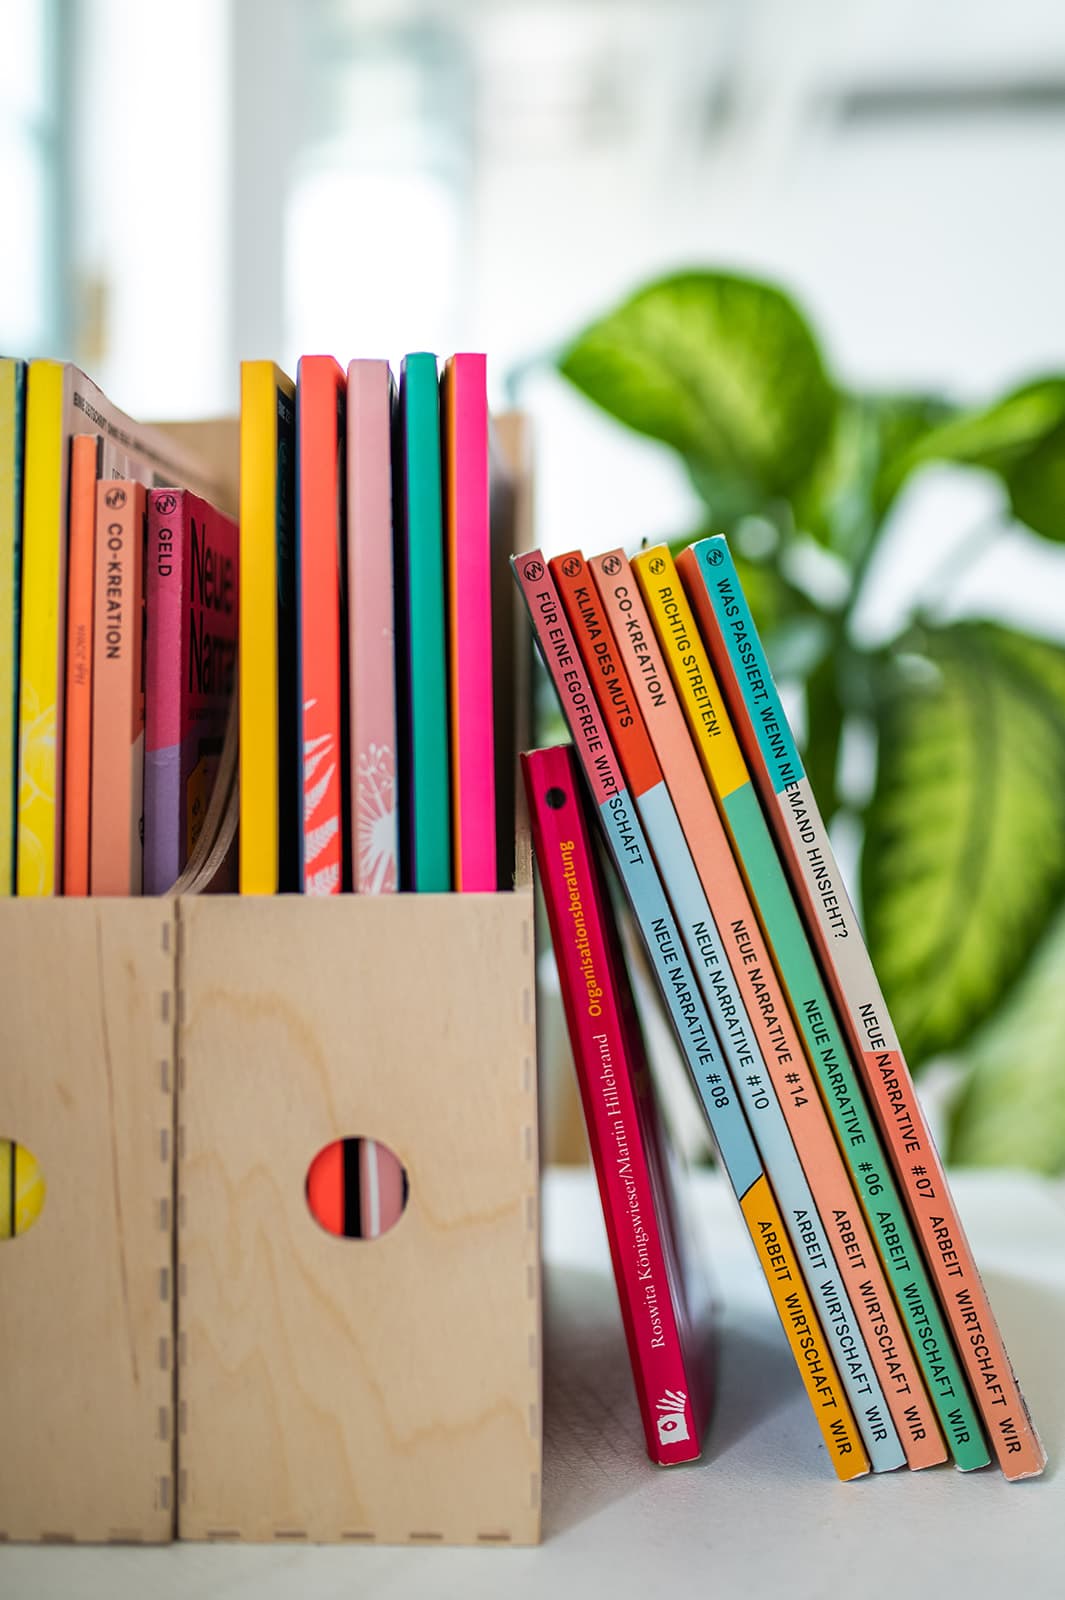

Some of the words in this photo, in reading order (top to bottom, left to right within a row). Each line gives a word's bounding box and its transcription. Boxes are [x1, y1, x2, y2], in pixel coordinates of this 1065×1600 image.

[106, 523, 123, 659] CO-KREATION
[158, 528, 173, 577] GELD
[190, 517, 232, 615] Neue
[614, 586, 667, 707] CO-KREATION
[536, 592, 558, 625] FÜR
[549, 628, 573, 668] EINE
[564, 670, 603, 752] EGOFREIE
[594, 754, 644, 865] WIRTSCHAFT
[574, 587, 602, 640] KLIMA
[593, 642, 615, 676] DES
[606, 678, 634, 728] MUTS
[658, 587, 691, 651] RICHTIG
[683, 655, 722, 737] STREITEN!
[716, 578, 739, 617] WAS
[730, 621, 769, 705] PASSIERT,
[760, 706, 788, 759] WENN
[778, 762, 816, 844] NIEMAND
[806, 847, 848, 939] HINSIEHT?
[560, 840, 603, 1017] Organisationsberatung
[651, 918, 679, 964] NEUE
[668, 967, 714, 1065] NARRATIVE
[706, 1073, 730, 1109] #08
[692, 921, 719, 967] NEUE
[709, 970, 754, 1067] NARRATIVE
[746, 1074, 770, 1110] #10
[730, 919, 758, 965] NEUE
[748, 968, 793, 1065] NARRATIVE
[785, 1072, 809, 1108] #14
[593, 1034, 622, 1116] Hillebrand
[803, 999, 831, 1046] NEUE
[820, 1048, 866, 1147] NARRATIVE
[858, 1162, 884, 1196] #06
[858, 1003, 886, 1050] NEUE
[875, 1053, 921, 1154] NARRATIVE
[911, 1165, 935, 1199] #07
[611, 1120, 653, 1281] Königswieser/Martin
[643, 1285, 665, 1349] Roswita
[757, 1221, 793, 1282] ARBEIT
[785, 1292, 838, 1409] WIRTSCHAFT
[829, 1419, 852, 1456] WIR
[793, 1209, 827, 1270] ARBEIT
[820, 1280, 873, 1396] WIRTSCHAFT
[865, 1405, 888, 1443] WIR
[832, 1209, 867, 1270] ARBEIT
[859, 1280, 912, 1396] WIRTSCHAFT
[904, 1405, 927, 1442] WIR
[876, 1211, 911, 1272] ARBEIT
[903, 1282, 956, 1399] WIRTSCHAFT
[947, 1408, 971, 1446] WIR
[929, 1216, 964, 1278] ARBEIT
[955, 1288, 1008, 1407] WIRTSCHAFT
[999, 1417, 1022, 1454] WIR
